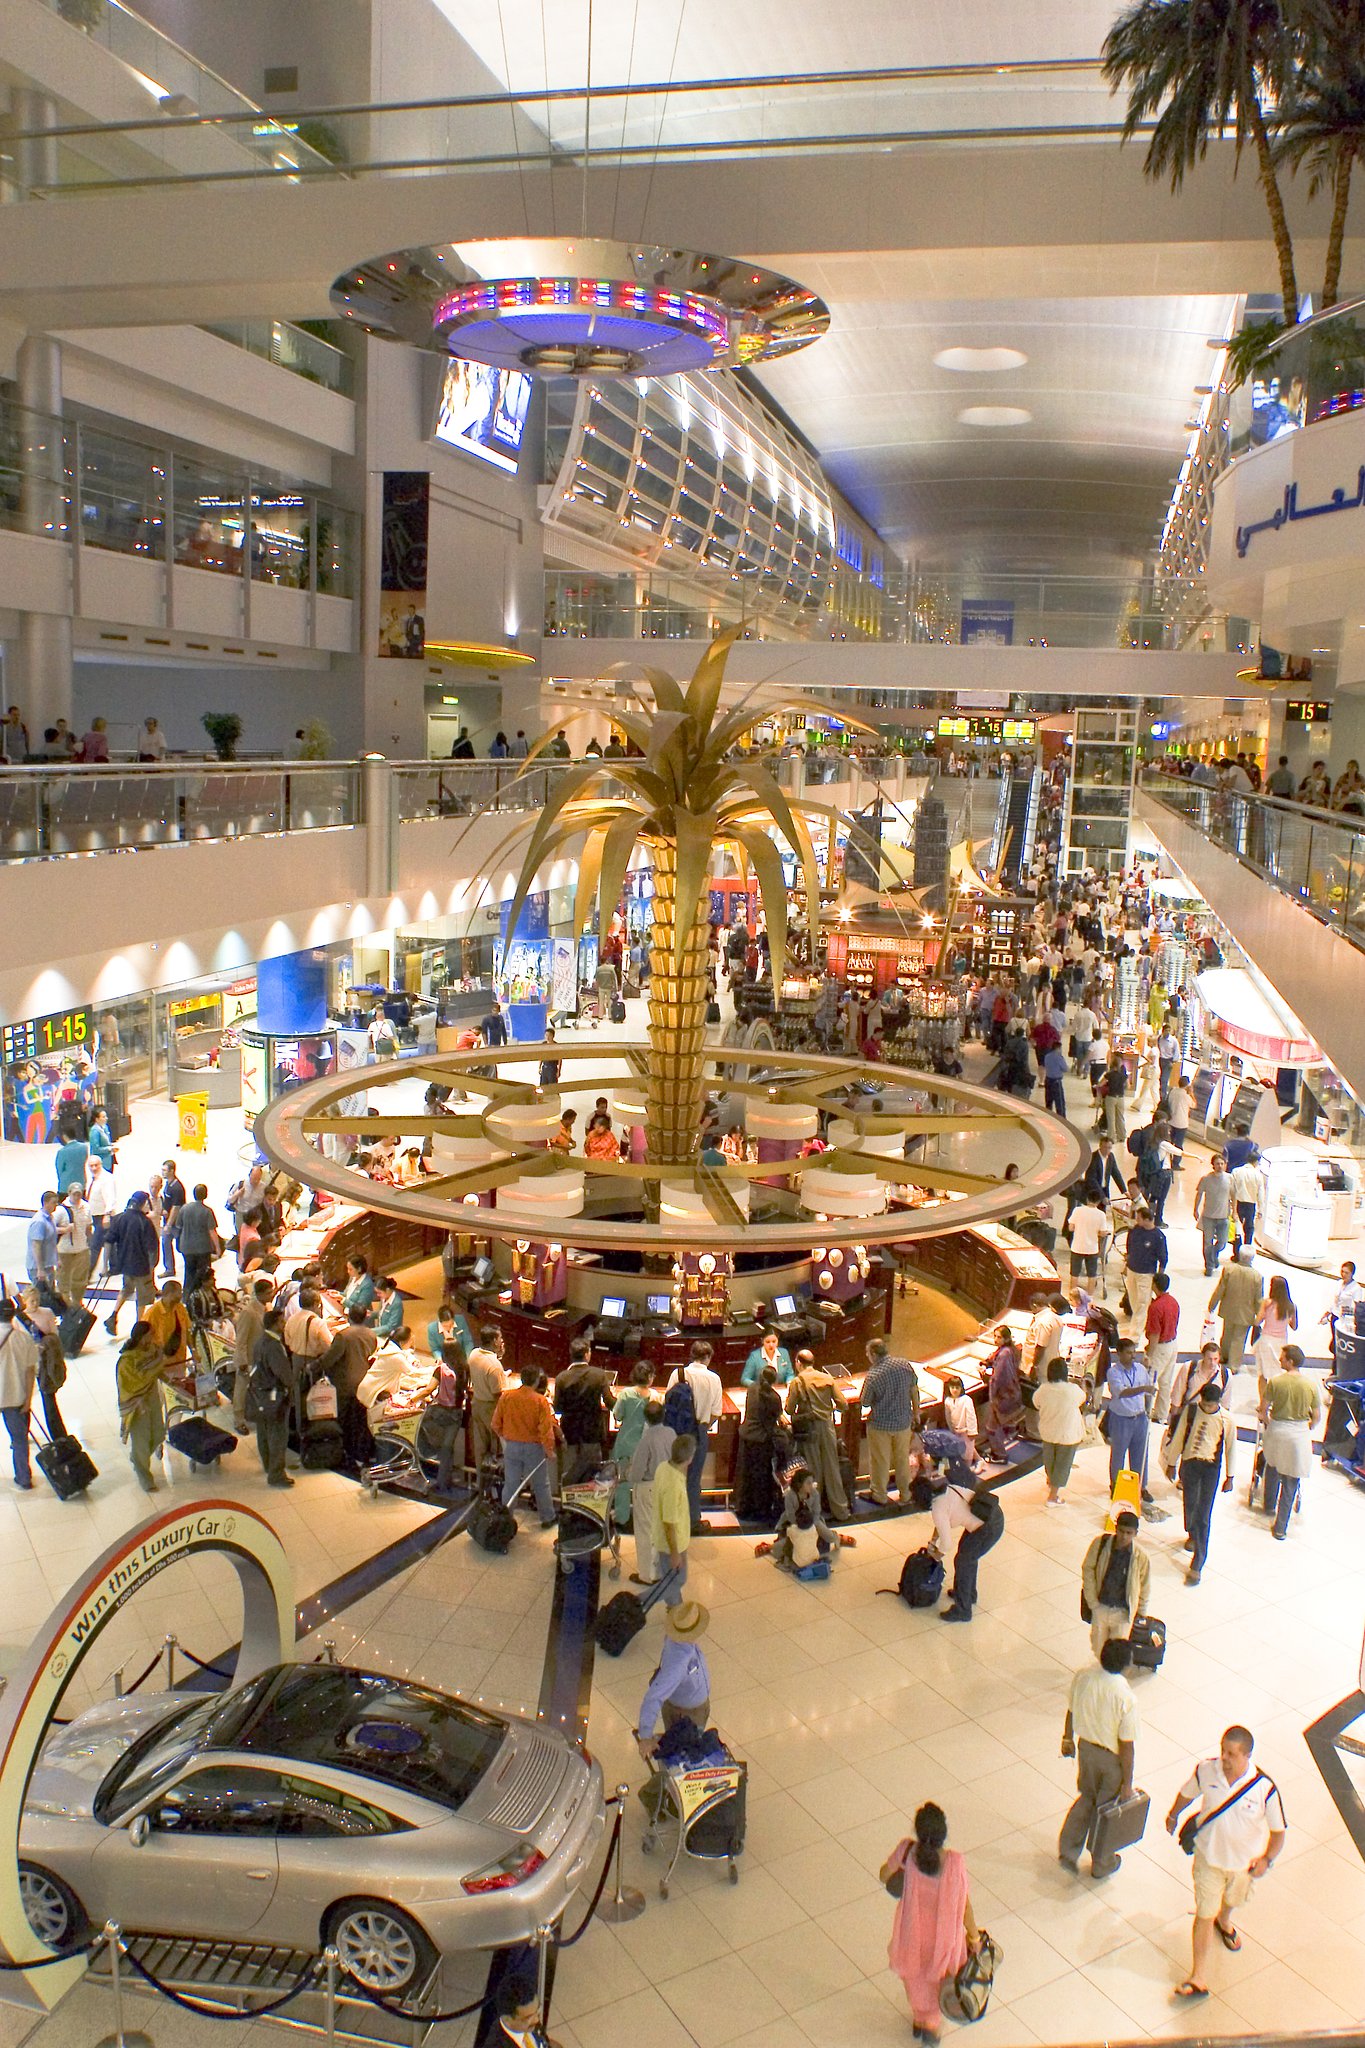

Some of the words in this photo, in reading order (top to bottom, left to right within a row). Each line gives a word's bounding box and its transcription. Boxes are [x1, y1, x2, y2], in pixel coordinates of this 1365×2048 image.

[1301, 703, 1314, 720] 15
[42, 1012, 87, 1048] 1-15
[70, 1594, 107, 1643] Win
[108, 1558, 140, 1594] this
[141, 1524, 193, 1563] Luxury
[196, 1516, 220, 1536] Car
